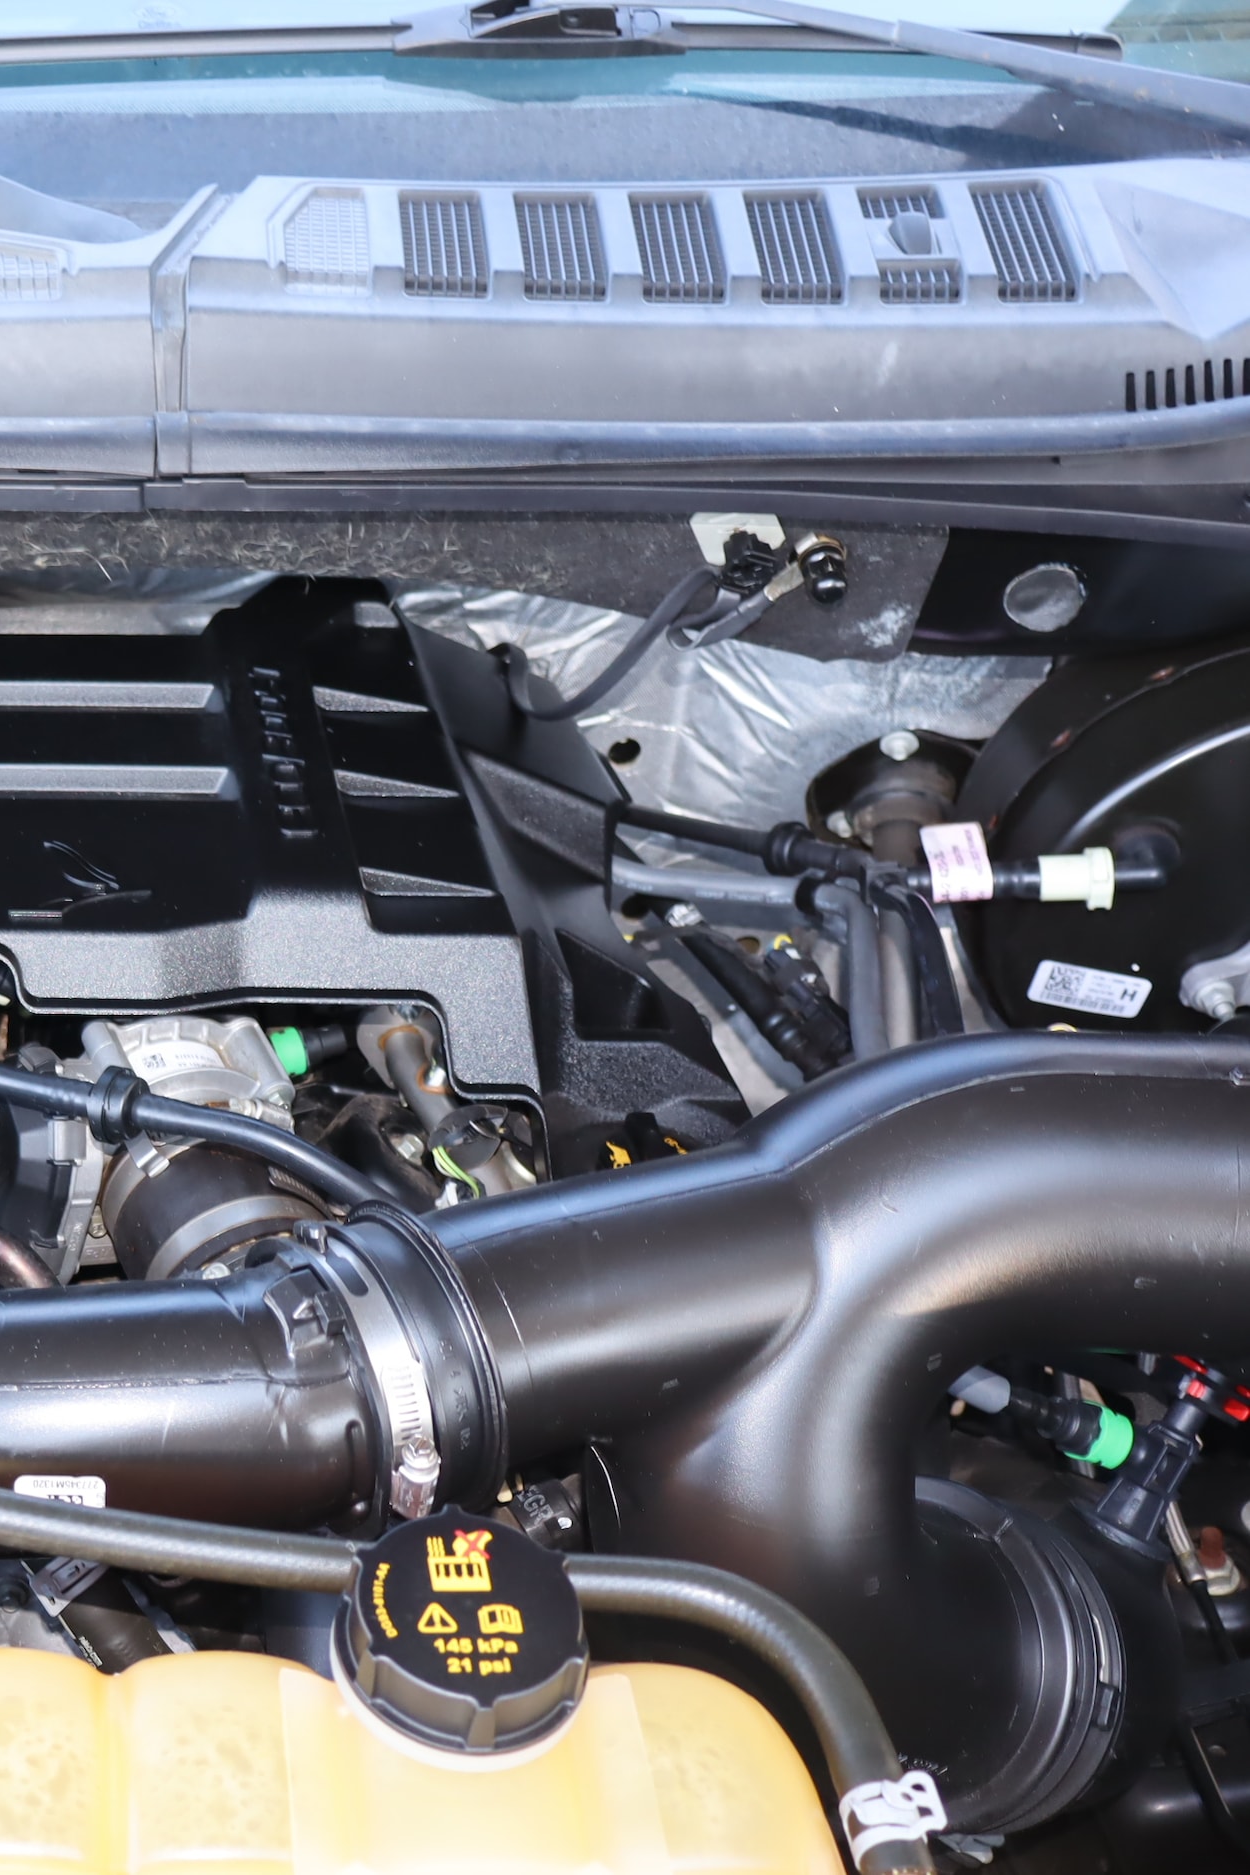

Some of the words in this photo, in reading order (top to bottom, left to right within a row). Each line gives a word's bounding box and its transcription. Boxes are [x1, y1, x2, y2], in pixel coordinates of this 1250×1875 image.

[1121, 988, 1138, 1002] H
[433, 1637, 473, 1653] 145
[477, 1637, 519, 1653] kPa
[447, 1657, 472, 1673] 21
[479, 1657, 512, 1677] psi
